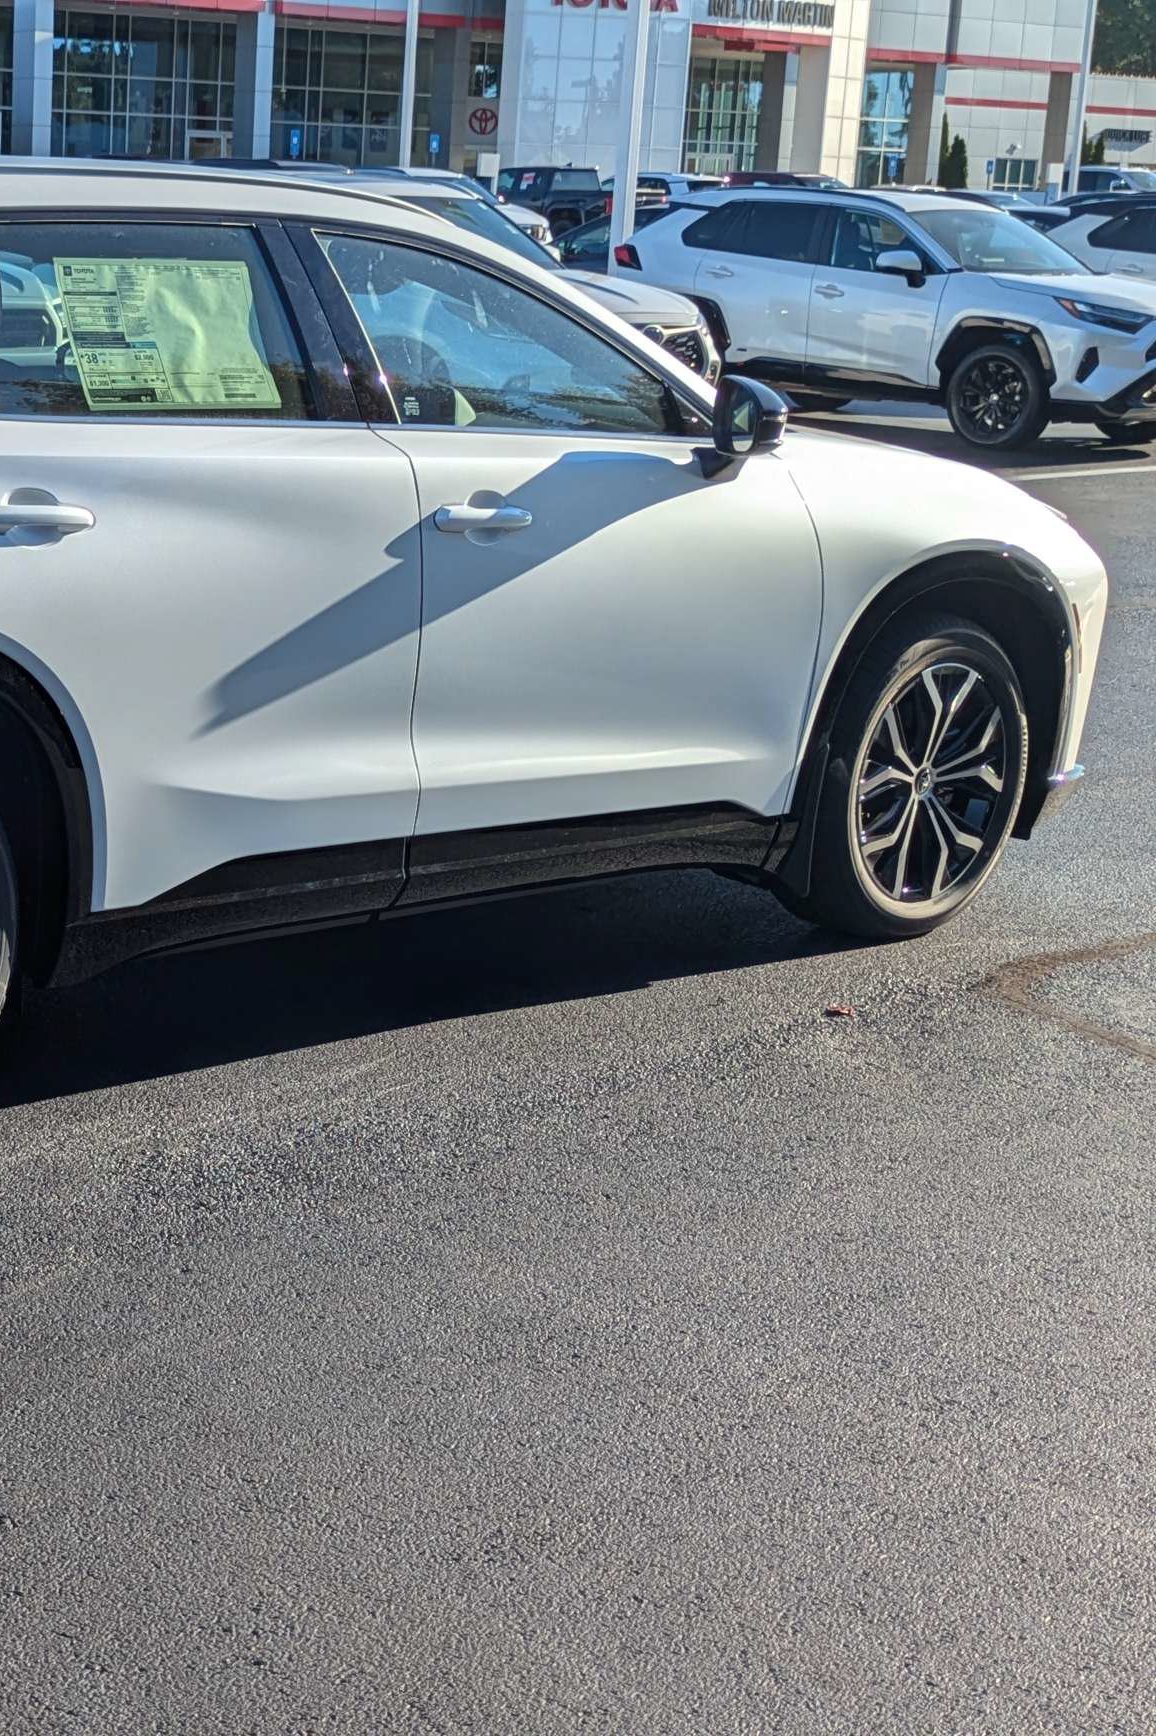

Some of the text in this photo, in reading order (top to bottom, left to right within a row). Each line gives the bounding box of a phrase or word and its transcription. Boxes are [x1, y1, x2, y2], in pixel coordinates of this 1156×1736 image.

[708, 0, 774, 21] MILTON
[777, 0, 834, 28] MARTIN
[84, 352, 99, 364] 38
